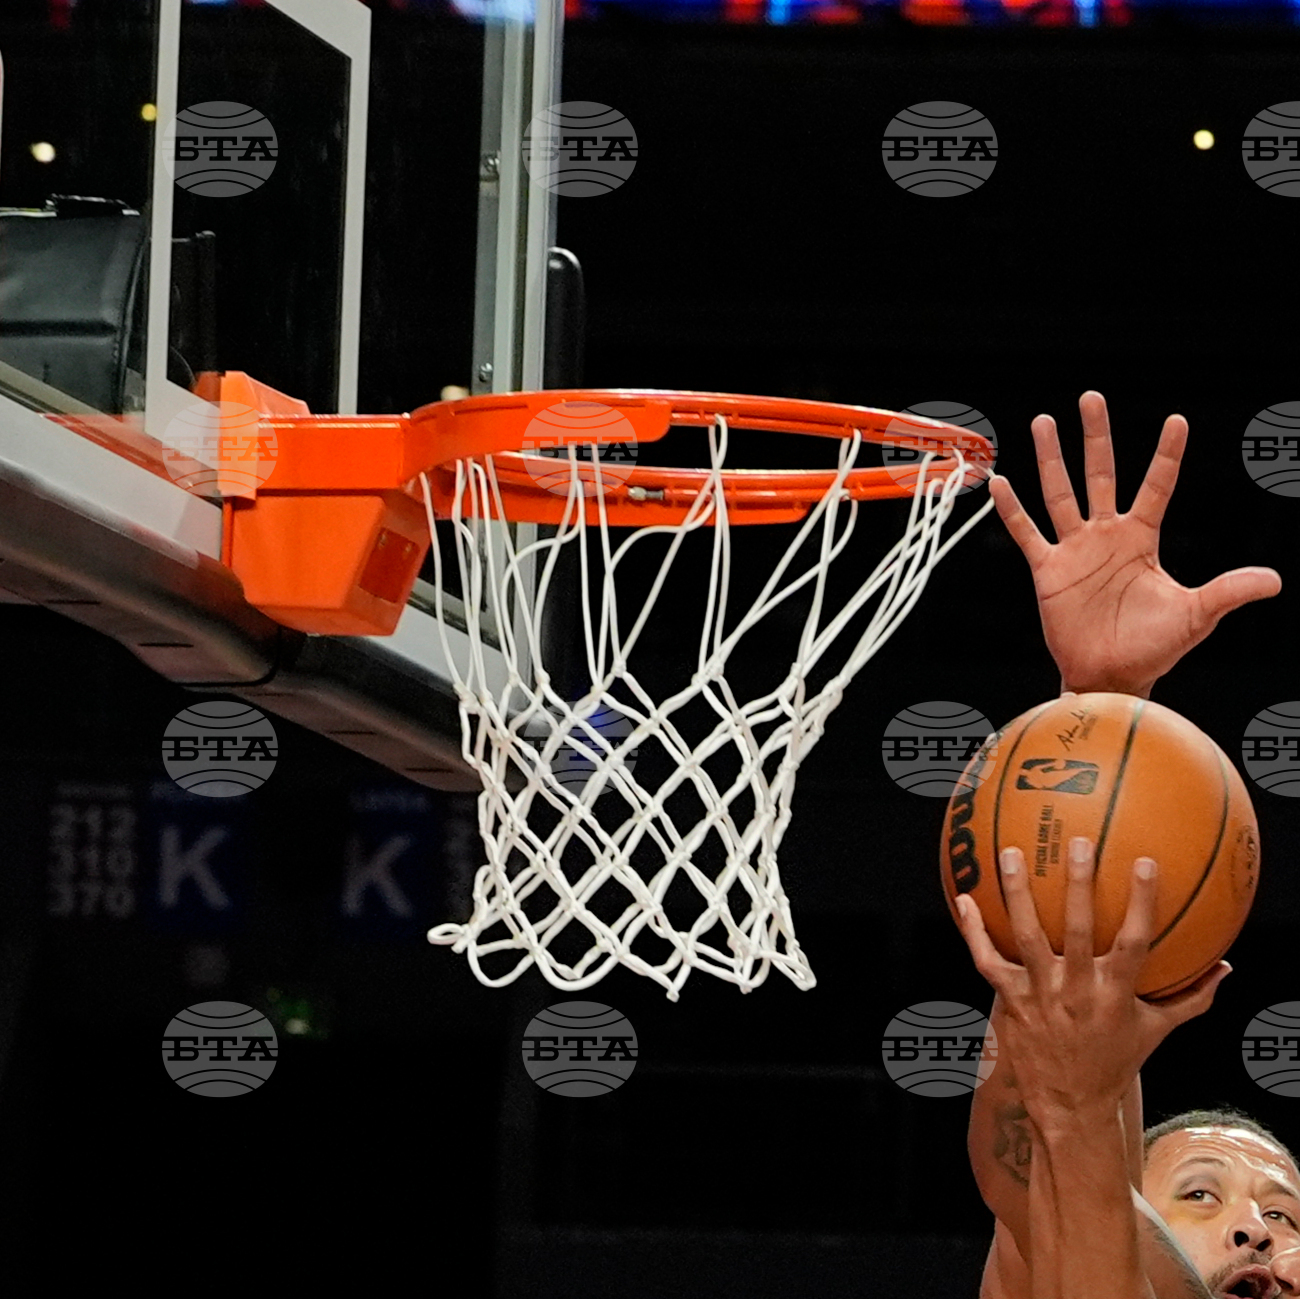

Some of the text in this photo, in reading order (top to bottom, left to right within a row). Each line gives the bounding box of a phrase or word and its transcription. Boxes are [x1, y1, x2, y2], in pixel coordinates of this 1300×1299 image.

[47, 881, 136, 918] 370
[158, 825, 232, 909] K
[341, 830, 414, 918] K
